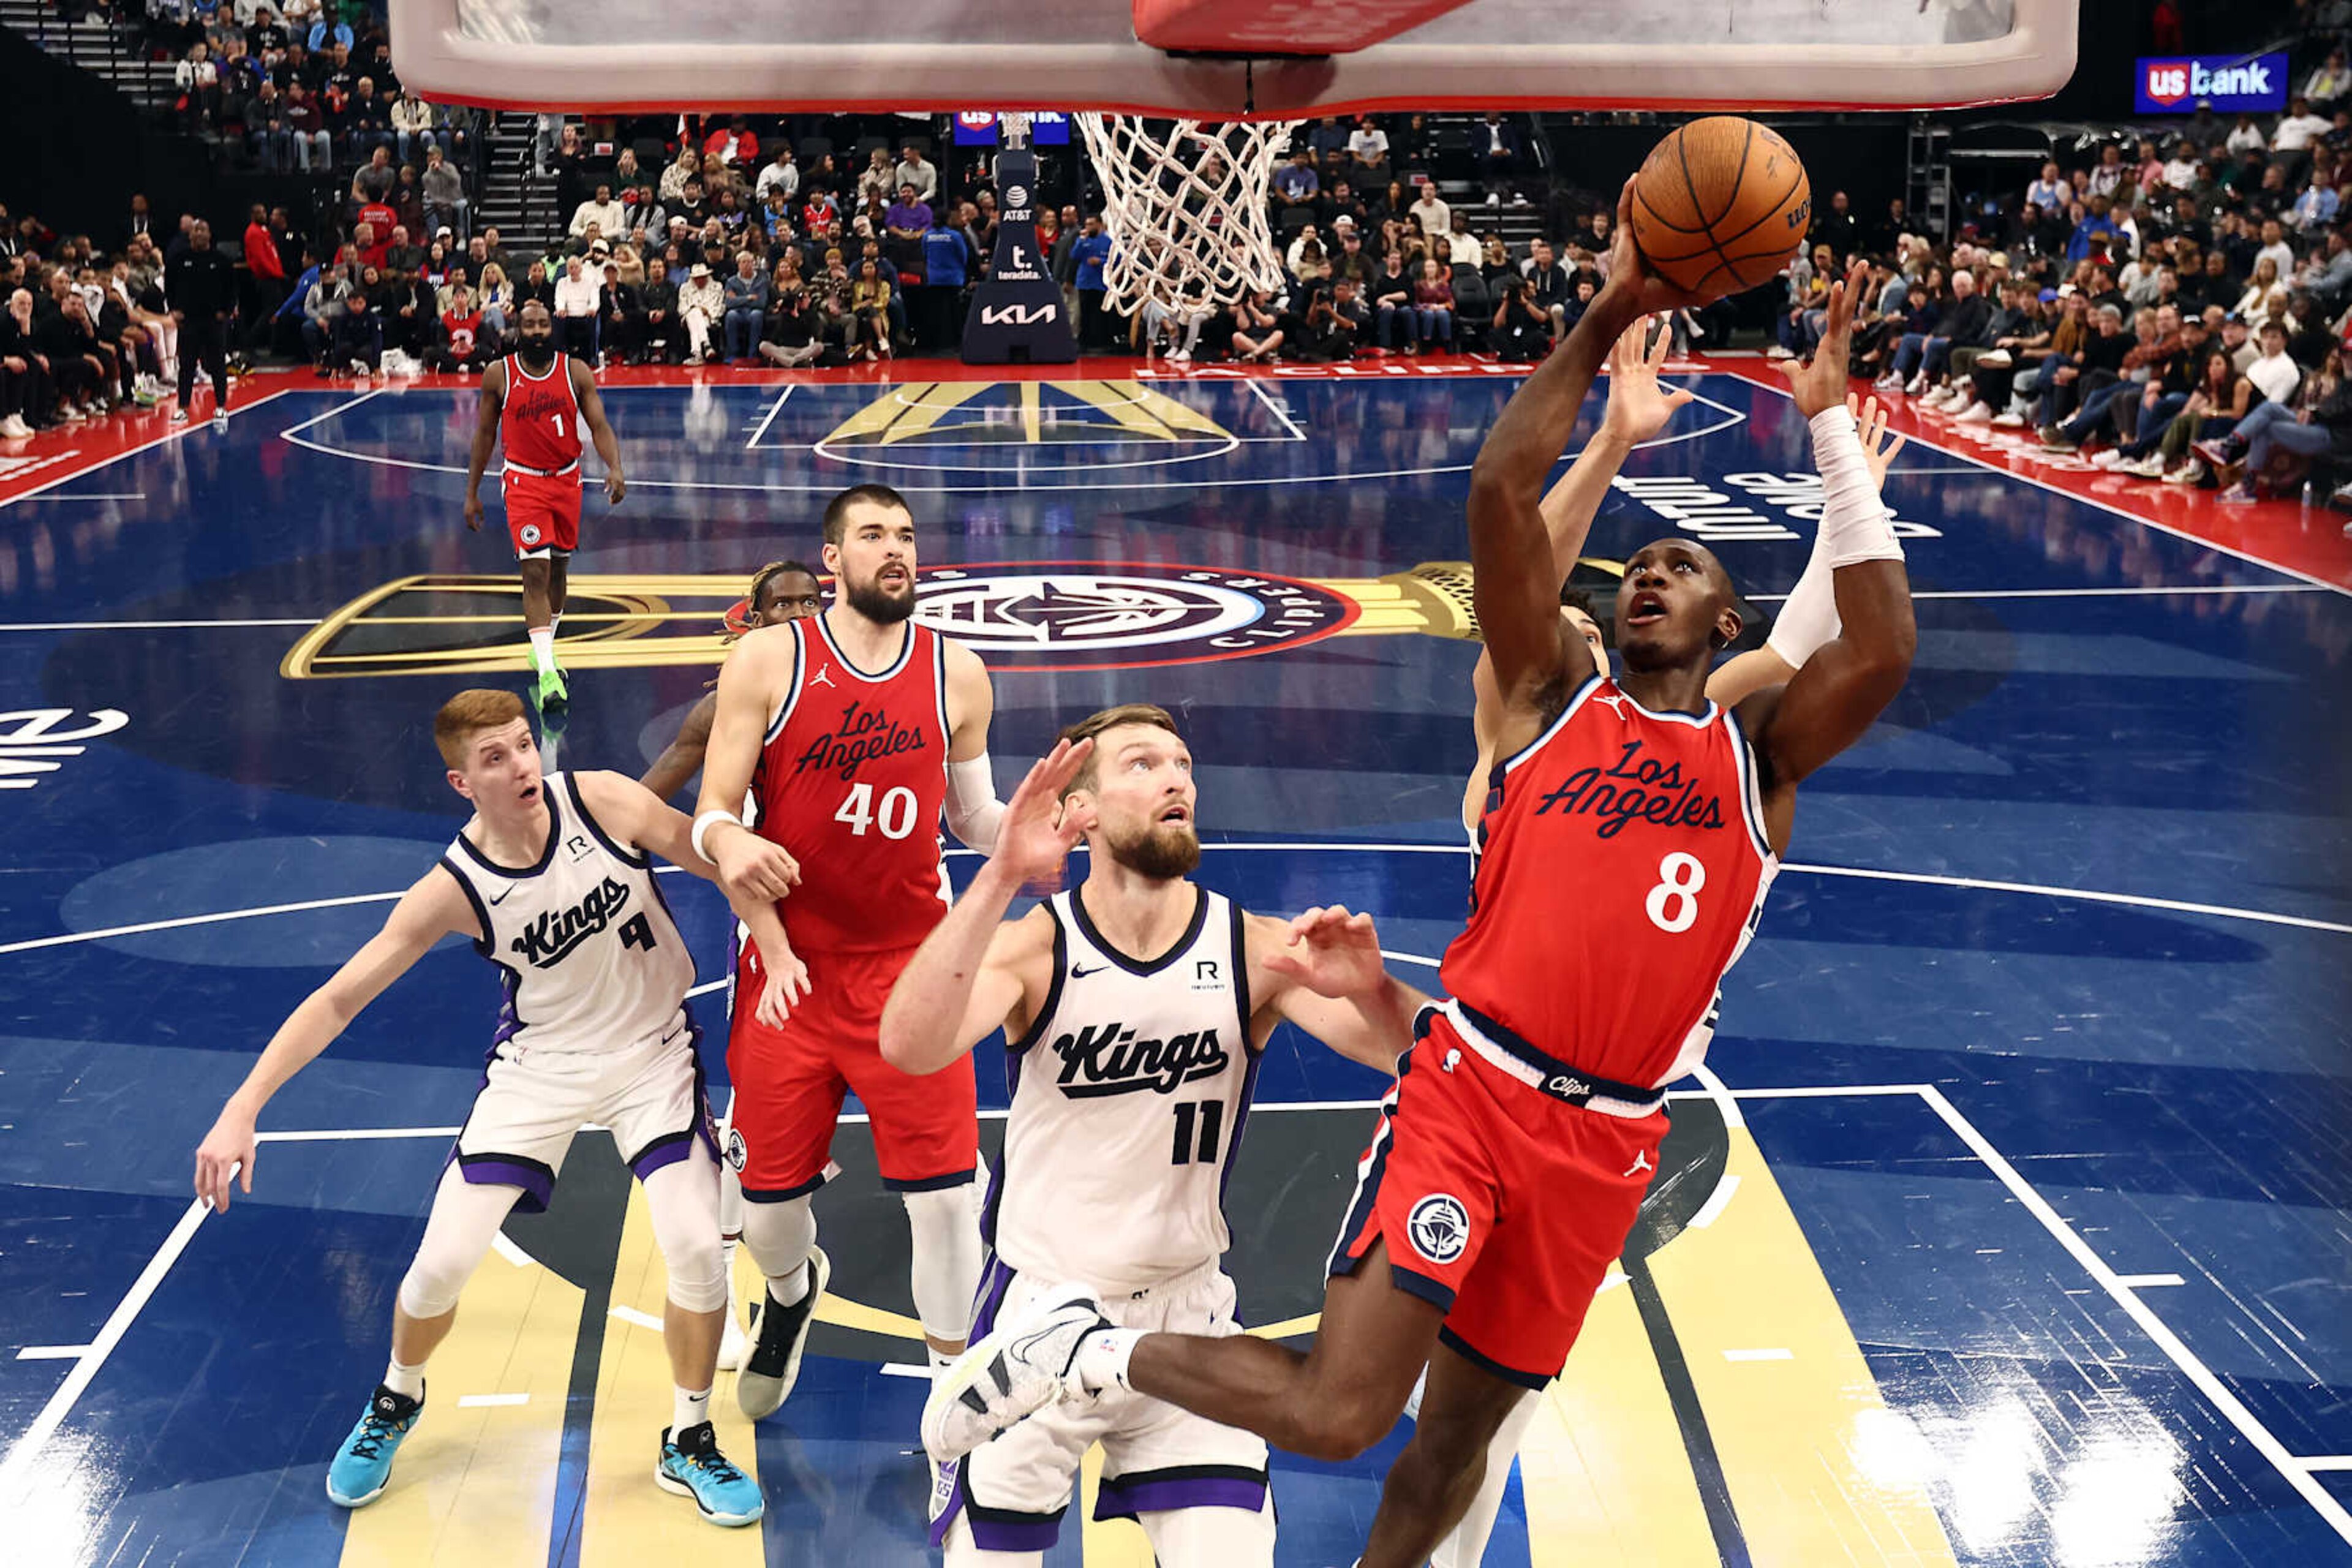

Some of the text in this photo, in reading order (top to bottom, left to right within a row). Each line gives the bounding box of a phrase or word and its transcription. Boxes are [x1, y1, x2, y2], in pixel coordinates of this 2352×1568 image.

[2150, 61, 2273, 96] us bank
[1003, 209, 1031, 222] AT&T
[982, 304, 1056, 325] KIA
[551, 413, 564, 437] 1
[1181, 572, 1324, 647] CLIPPERS
[837, 701, 888, 738] Los
[796, 722, 926, 781] Angeles
[1606, 740, 1684, 789] Los
[834, 783, 918, 840] 40
[1534, 767, 1725, 839] Angeles
[567, 835, 587, 854] R
[1645, 851, 1706, 933] 8
[511, 876, 630, 968] Kings
[617, 912, 656, 952] 9
[1196, 961, 1218, 980] R
[1052, 1023, 1227, 1099] Kings
[1549, 1076, 1590, 1097] Clips
[1171, 1099, 1223, 1166] 11
